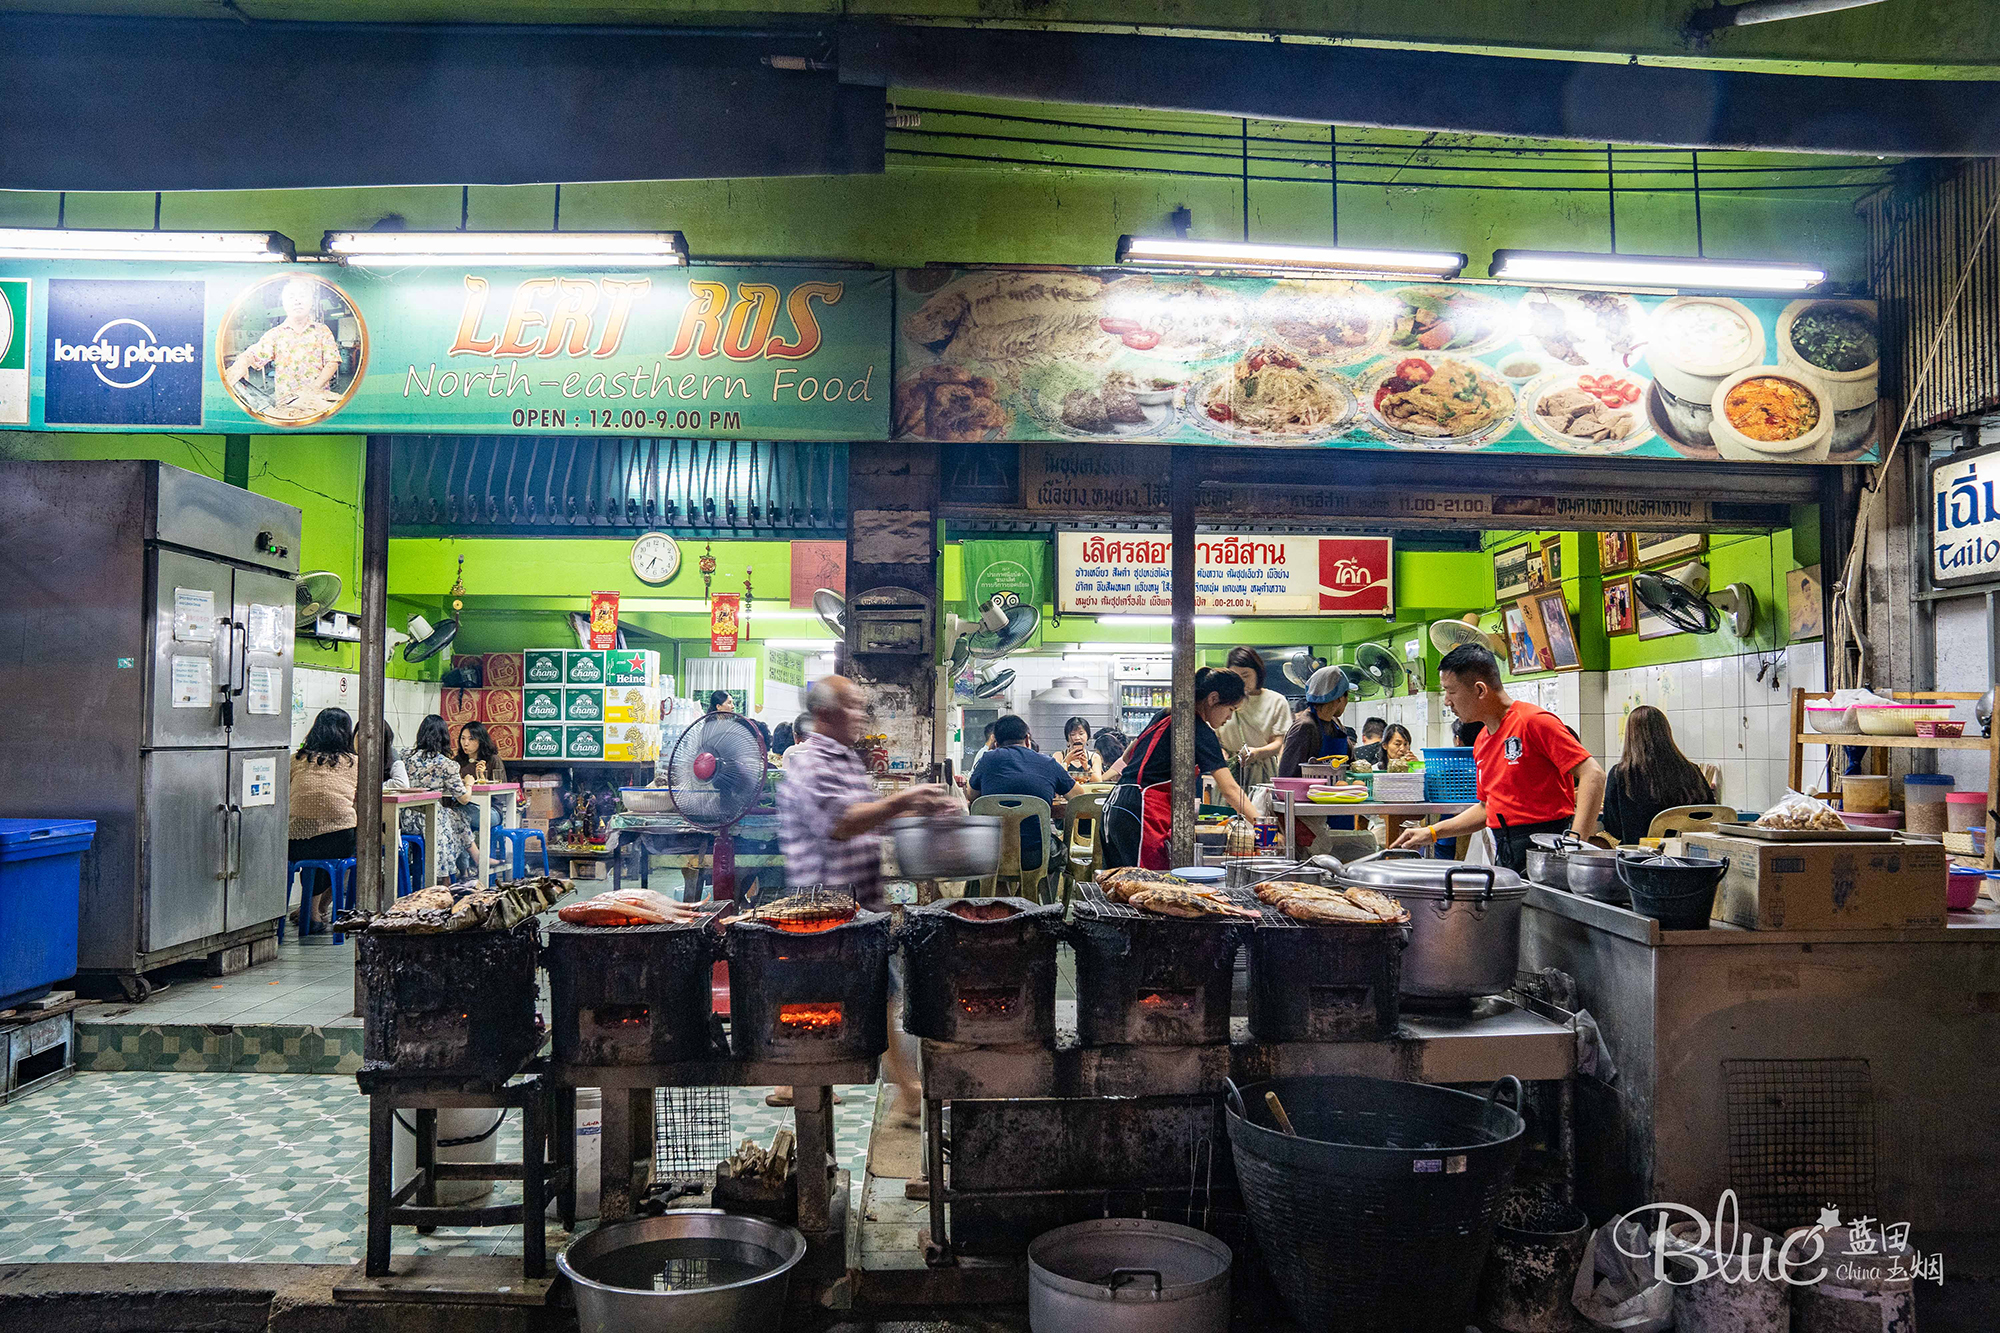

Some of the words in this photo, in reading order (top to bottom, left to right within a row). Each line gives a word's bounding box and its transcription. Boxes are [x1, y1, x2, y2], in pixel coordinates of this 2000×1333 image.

[448, 274, 652, 358] LERT
[665, 278, 844, 361] ROS
[54, 339, 119, 370] lonely
[124, 340, 195, 368] planet
[402, 360, 752, 401] North-easthern
[770, 365, 875, 403] Food
[512, 408, 566, 428] OPEN
[589, 410, 702, 430] 12.00-9.00
[709, 411, 741, 430] PM
[1082, 536, 1286, 565] เลิศรสอารอีสาน
[530, 669, 558, 678] Chang
[571, 669, 599, 679] Chang
[489, 700, 515, 717] LEO
[528, 706, 557, 716] Chang
[570, 706, 598, 716] Chang
[496, 736, 515, 752] EO
[529, 743, 557, 753] Chang
[571, 744, 599, 753] Chang
